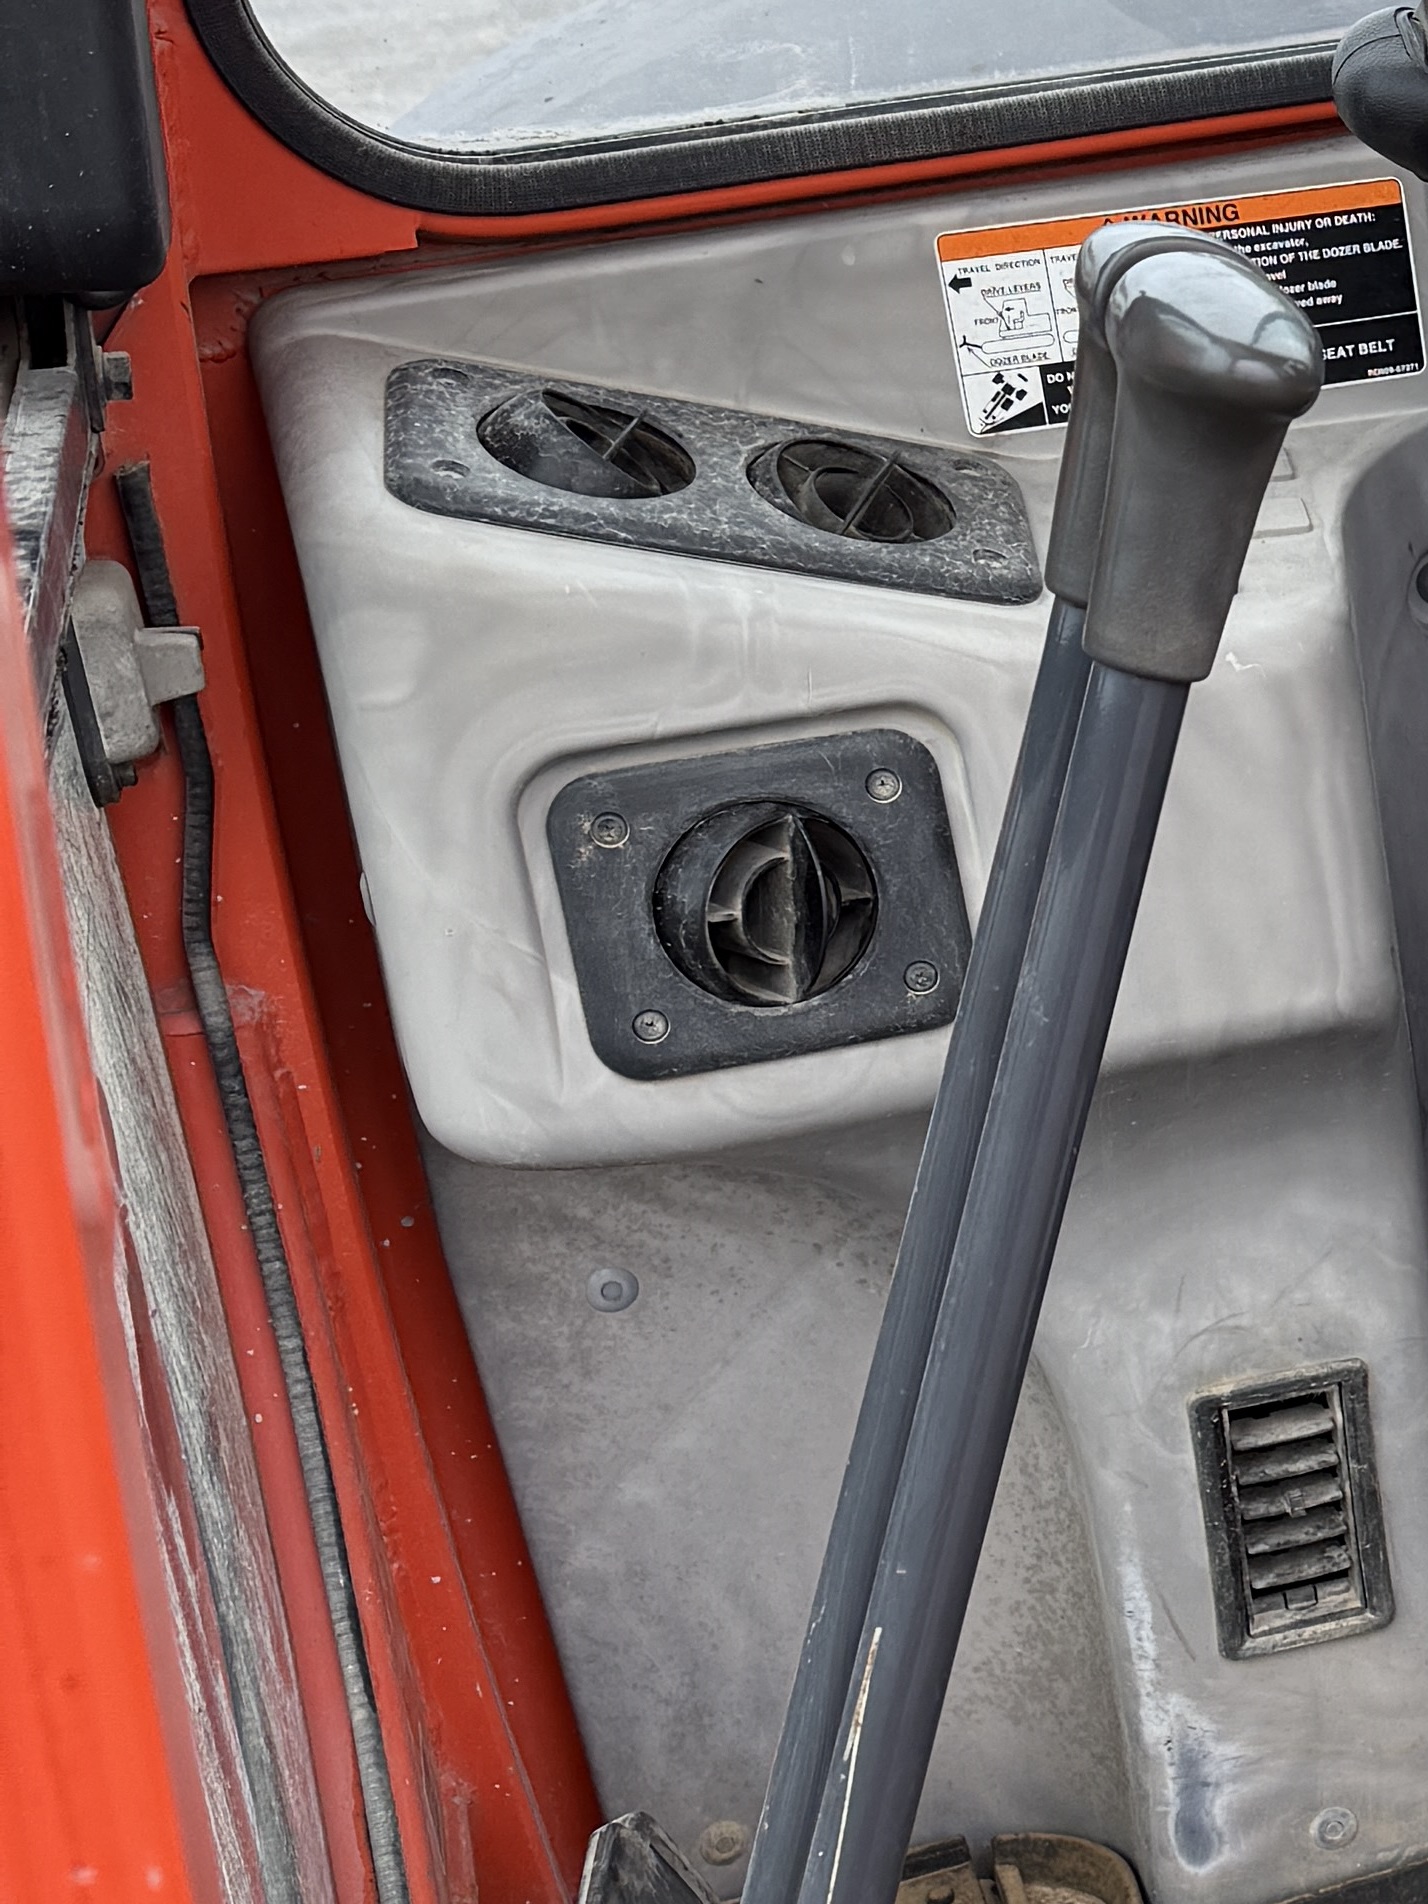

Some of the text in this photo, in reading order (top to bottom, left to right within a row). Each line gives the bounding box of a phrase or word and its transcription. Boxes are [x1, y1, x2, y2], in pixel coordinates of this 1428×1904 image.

[1210, 212, 1376, 241] ERSONAL INJURY OR DEATH:
[1253, 238, 1309, 252] excavator,
[1050, 254, 1076, 264] TRAVE
[1280, 253, 1295, 264] OF
[1298, 248, 1321, 262] THE
[1323, 245, 1361, 259] DOZER
[958, 258, 1041, 275] TRAVEL DIRECTION
[1280, 279, 1337, 294] ozer blade
[1316, 293, 1343, 306] away
[975, 317, 999, 326] FRONT
[1359, 339, 1395, 356] BELT
[990, 356, 1019, 367] DOZER
[1046, 374, 1065, 384] DO
